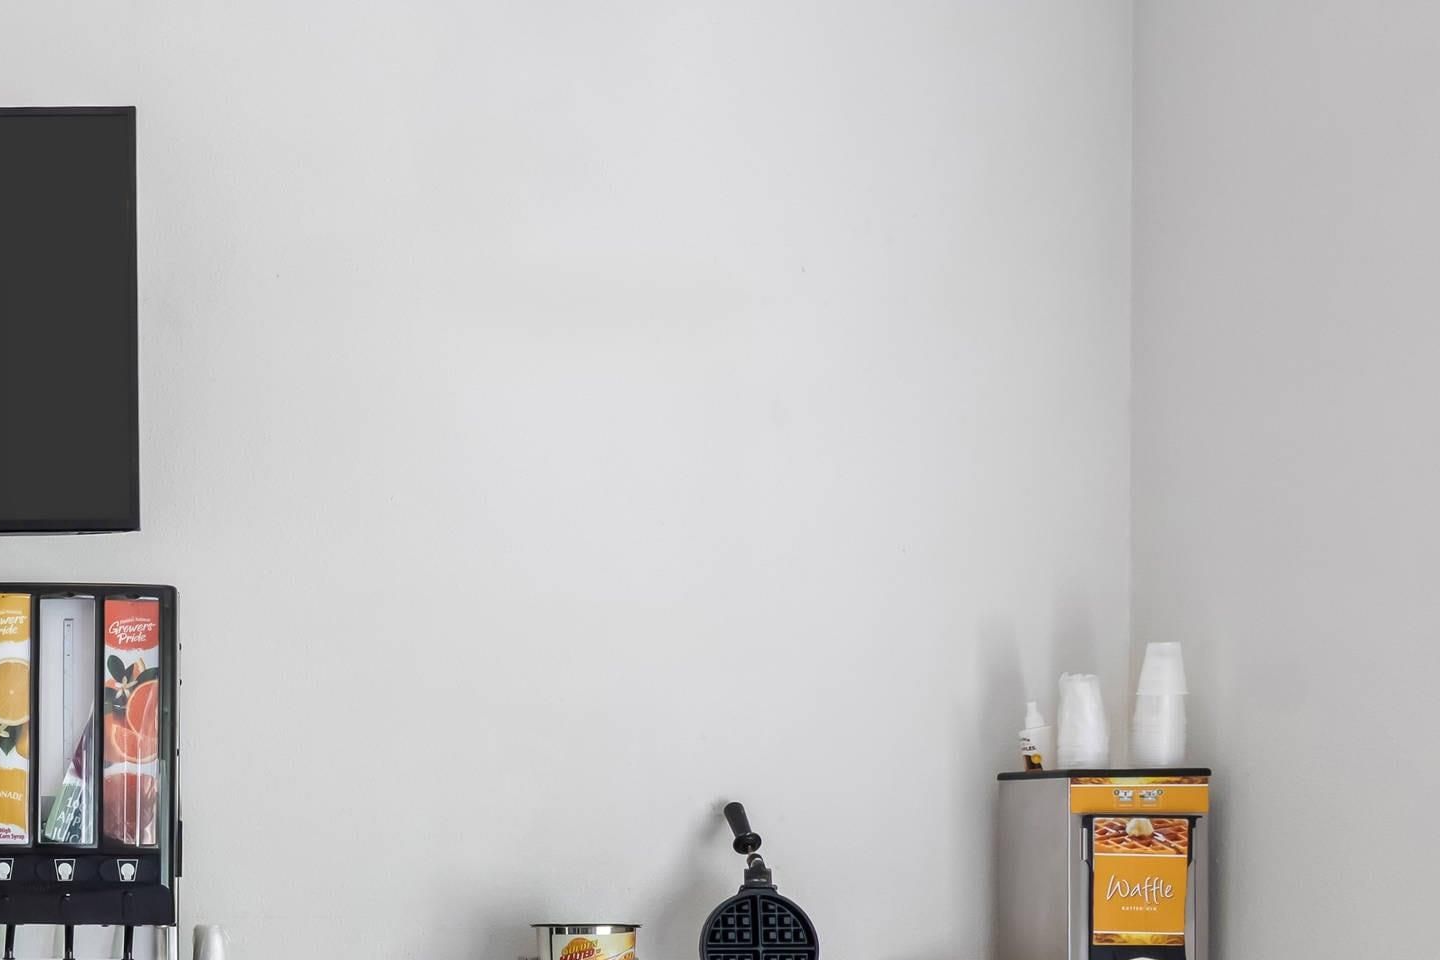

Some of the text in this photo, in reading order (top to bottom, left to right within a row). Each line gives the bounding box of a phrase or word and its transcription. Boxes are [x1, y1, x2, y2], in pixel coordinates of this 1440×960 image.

[109, 621, 155, 634] Growers
[117, 631, 146, 645] Pride
[1106, 874, 1174, 904] Waffle
